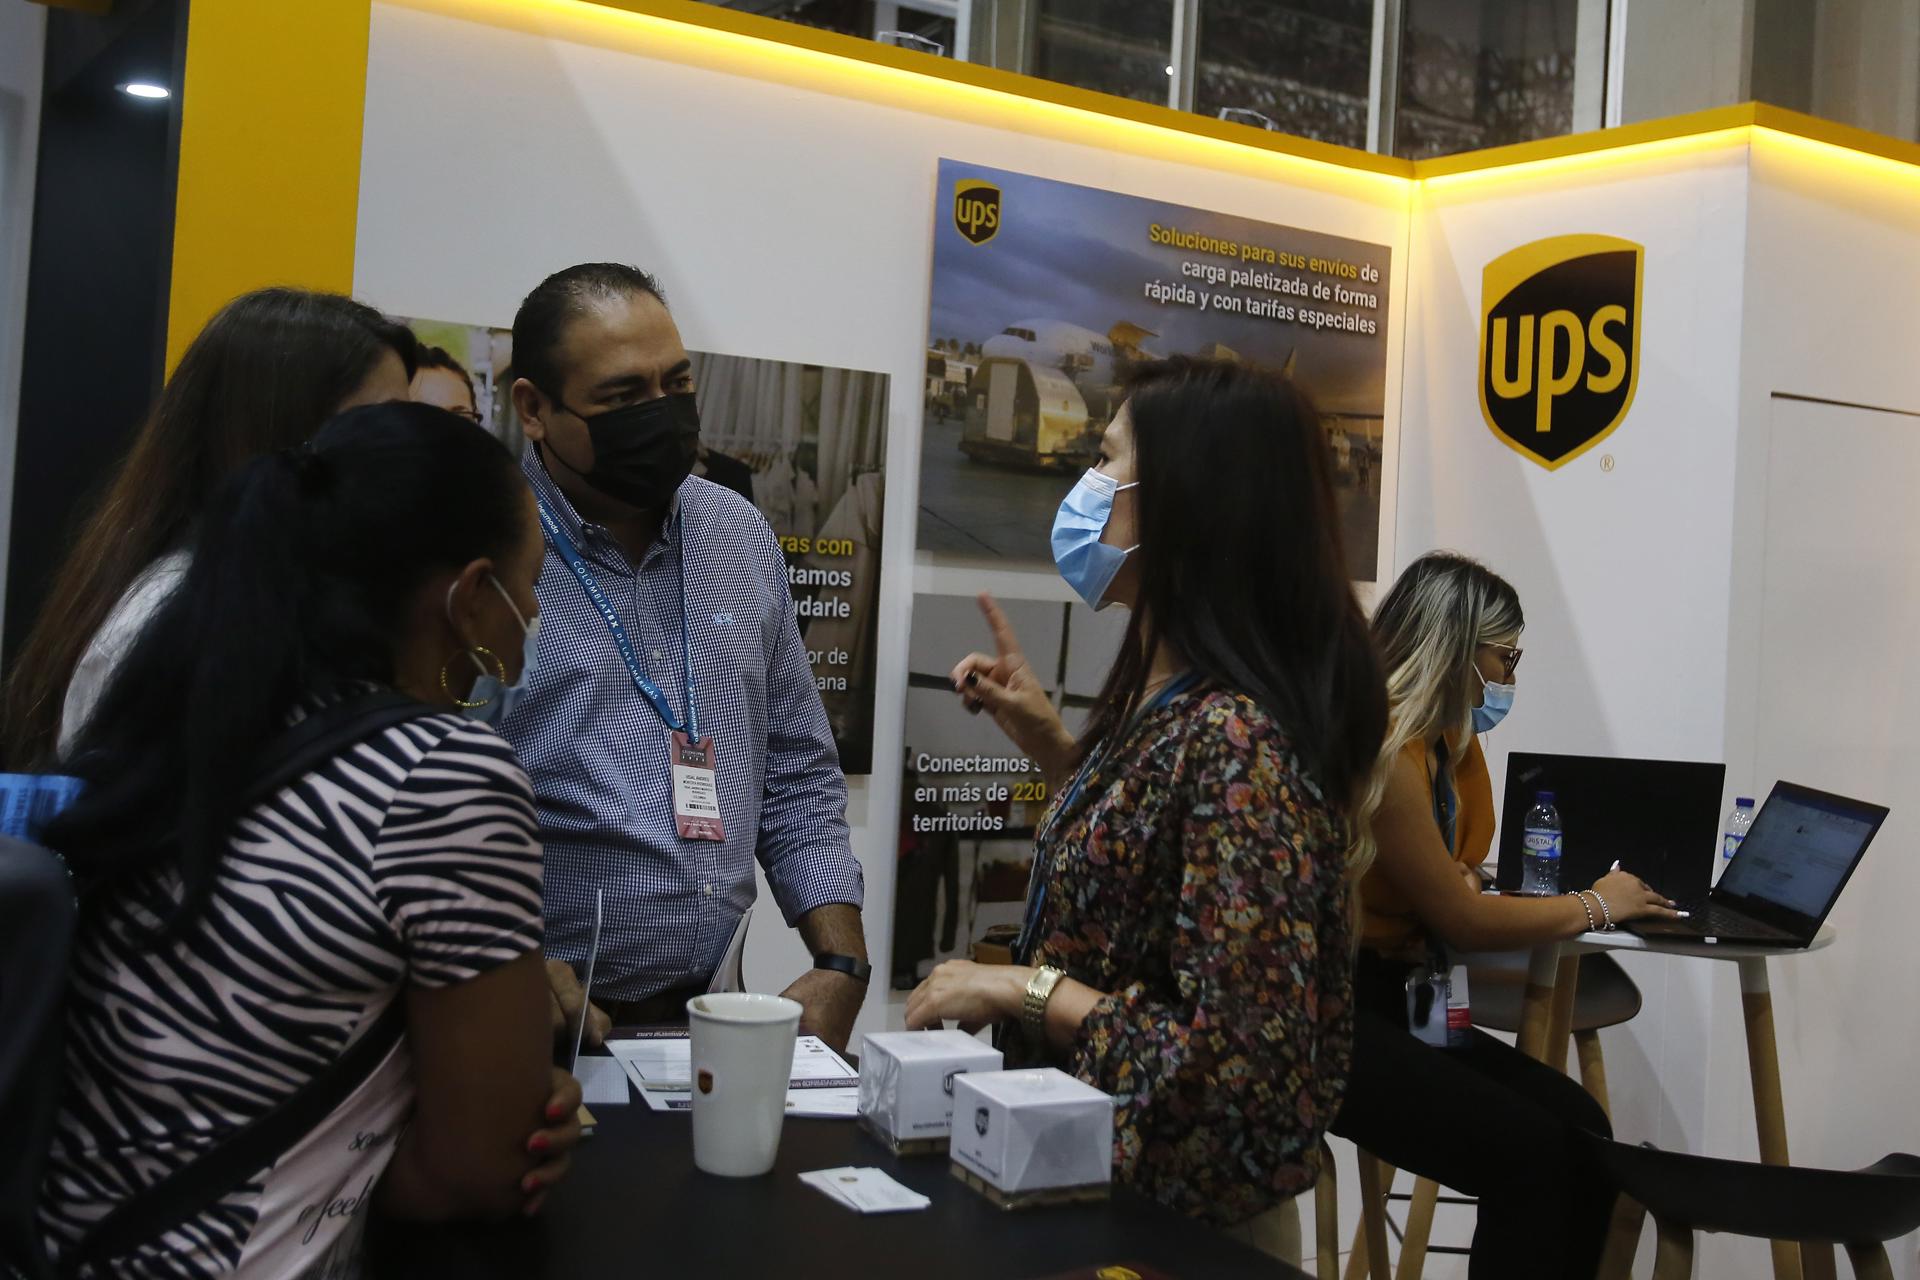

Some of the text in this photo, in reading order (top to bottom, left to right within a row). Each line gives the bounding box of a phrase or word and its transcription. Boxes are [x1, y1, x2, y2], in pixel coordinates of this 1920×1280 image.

[958, 198, 997, 235] ups
[1150, 223, 1379, 283] Soluciones para sus envíos de
[1182, 261, 1377, 308] carga paletizada de forma
[1145, 279, 1376, 334] rápida y con tarifas especiales
[1491, 304, 1626, 432] ups
[816, 538, 853, 556] con
[788, 565, 852, 587] tamos
[574, 560, 619, 629] COLOMBIATEX
[616, 632, 625, 645] DE
[622, 646, 632, 662] LAS
[807, 648, 848, 665] or de
[917, 753, 1030, 773] Conectamos
[915, 782, 1046, 802] en más de 220
[913, 812, 1004, 832] territorios
